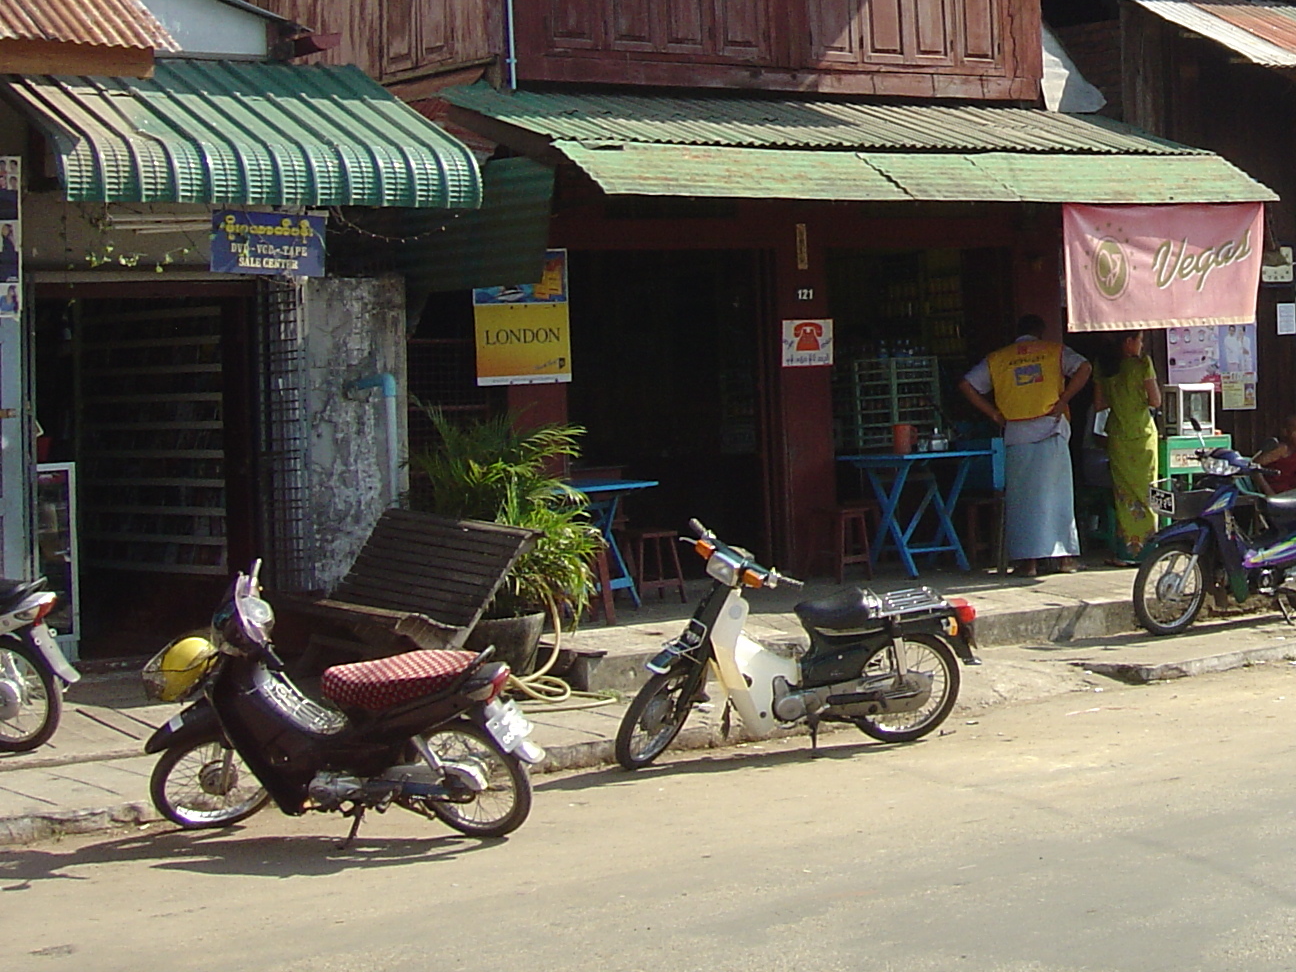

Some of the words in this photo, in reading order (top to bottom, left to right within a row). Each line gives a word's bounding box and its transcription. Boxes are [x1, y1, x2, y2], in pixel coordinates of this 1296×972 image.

[238, 256, 262, 268] SALE
[262, 258, 299, 270] CENTER
[1152, 228, 1253, 293] Vegas
[797, 288, 814, 300] 121
[485, 328, 561, 345] LONDON
